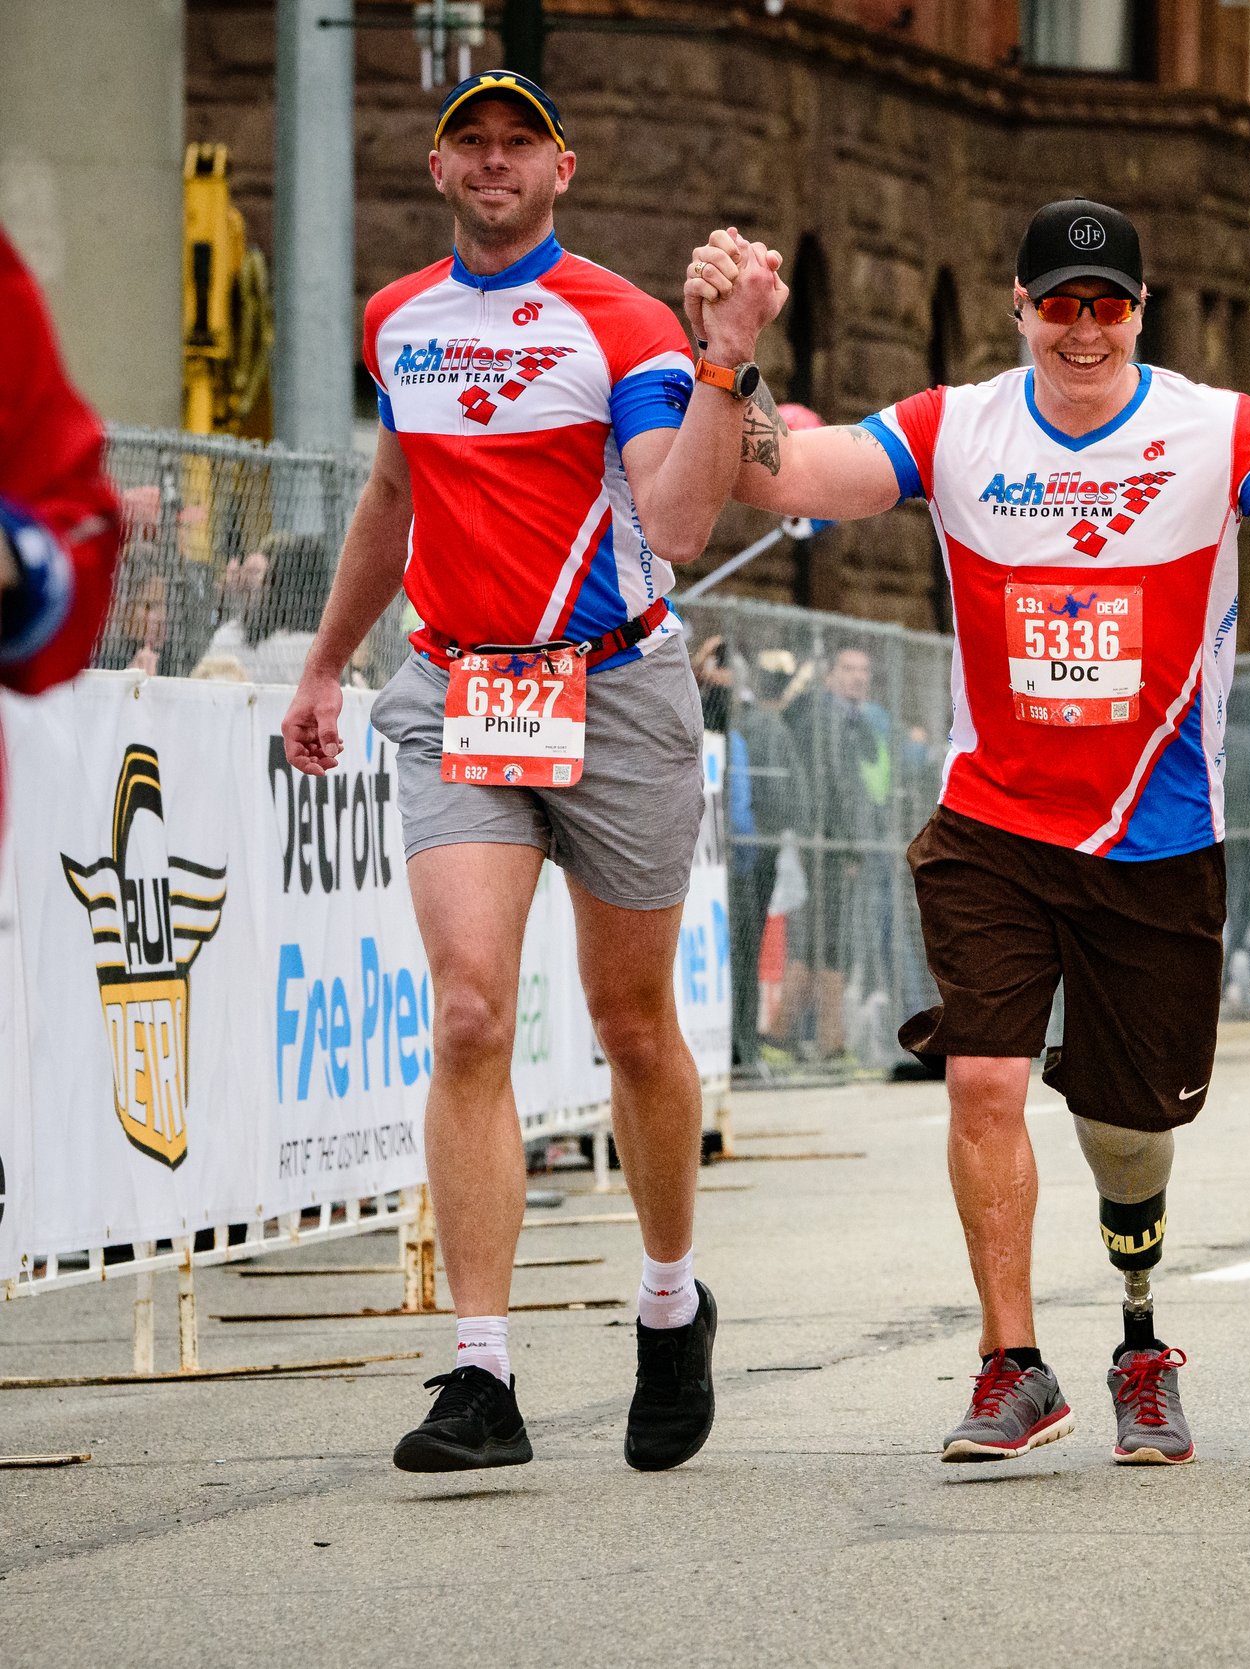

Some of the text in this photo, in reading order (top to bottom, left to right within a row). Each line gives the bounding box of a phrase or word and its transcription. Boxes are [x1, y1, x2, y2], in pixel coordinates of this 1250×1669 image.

[1073, 224, 1101, 245] DJF
[394, 338, 515, 376] Achilles
[400, 373, 505, 386] FREEDOM TEAM
[979, 472, 1118, 505] Achilles
[992, 504, 1113, 518] FREEDOM TEAM
[1024, 619, 1120, 660] 5336
[1051, 661, 1099, 682] Doc
[1026, 680, 1035, 691] H
[466, 676, 564, 718] 6327
[1029, 705, 1048, 721] 5336
[485, 717, 541, 738] Philip
[460, 737, 470, 748] H
[464, 765, 488, 780] 6327
[268, 728, 392, 895] Detroit
